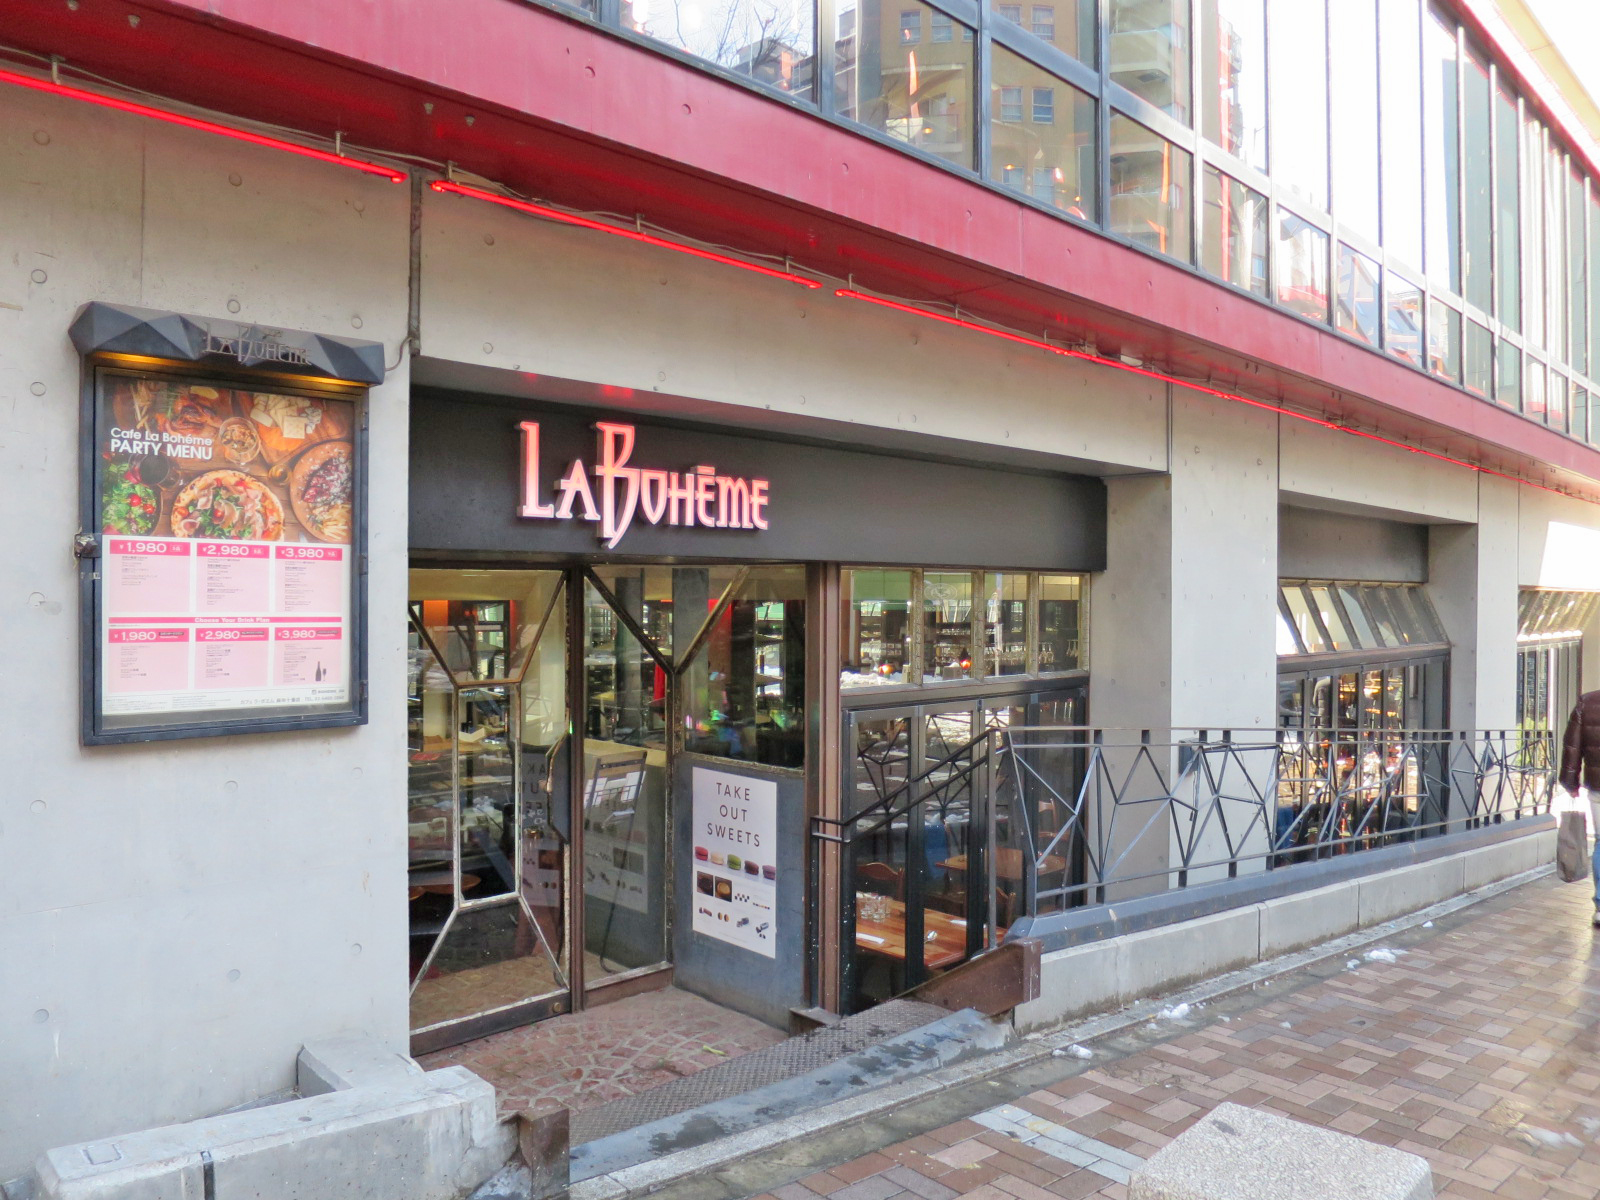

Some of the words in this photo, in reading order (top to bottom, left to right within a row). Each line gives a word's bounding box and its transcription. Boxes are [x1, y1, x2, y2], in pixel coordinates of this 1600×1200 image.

[111, 427, 142, 440] Cafe
[145, 430, 160, 442] La
[110, 438, 163, 456] PARTY
[166, 443, 213, 460] MENU
[716, 782, 750, 801] TAKE
[719, 804, 748, 822] OUT
[707, 822, 760, 847] SWEETS
